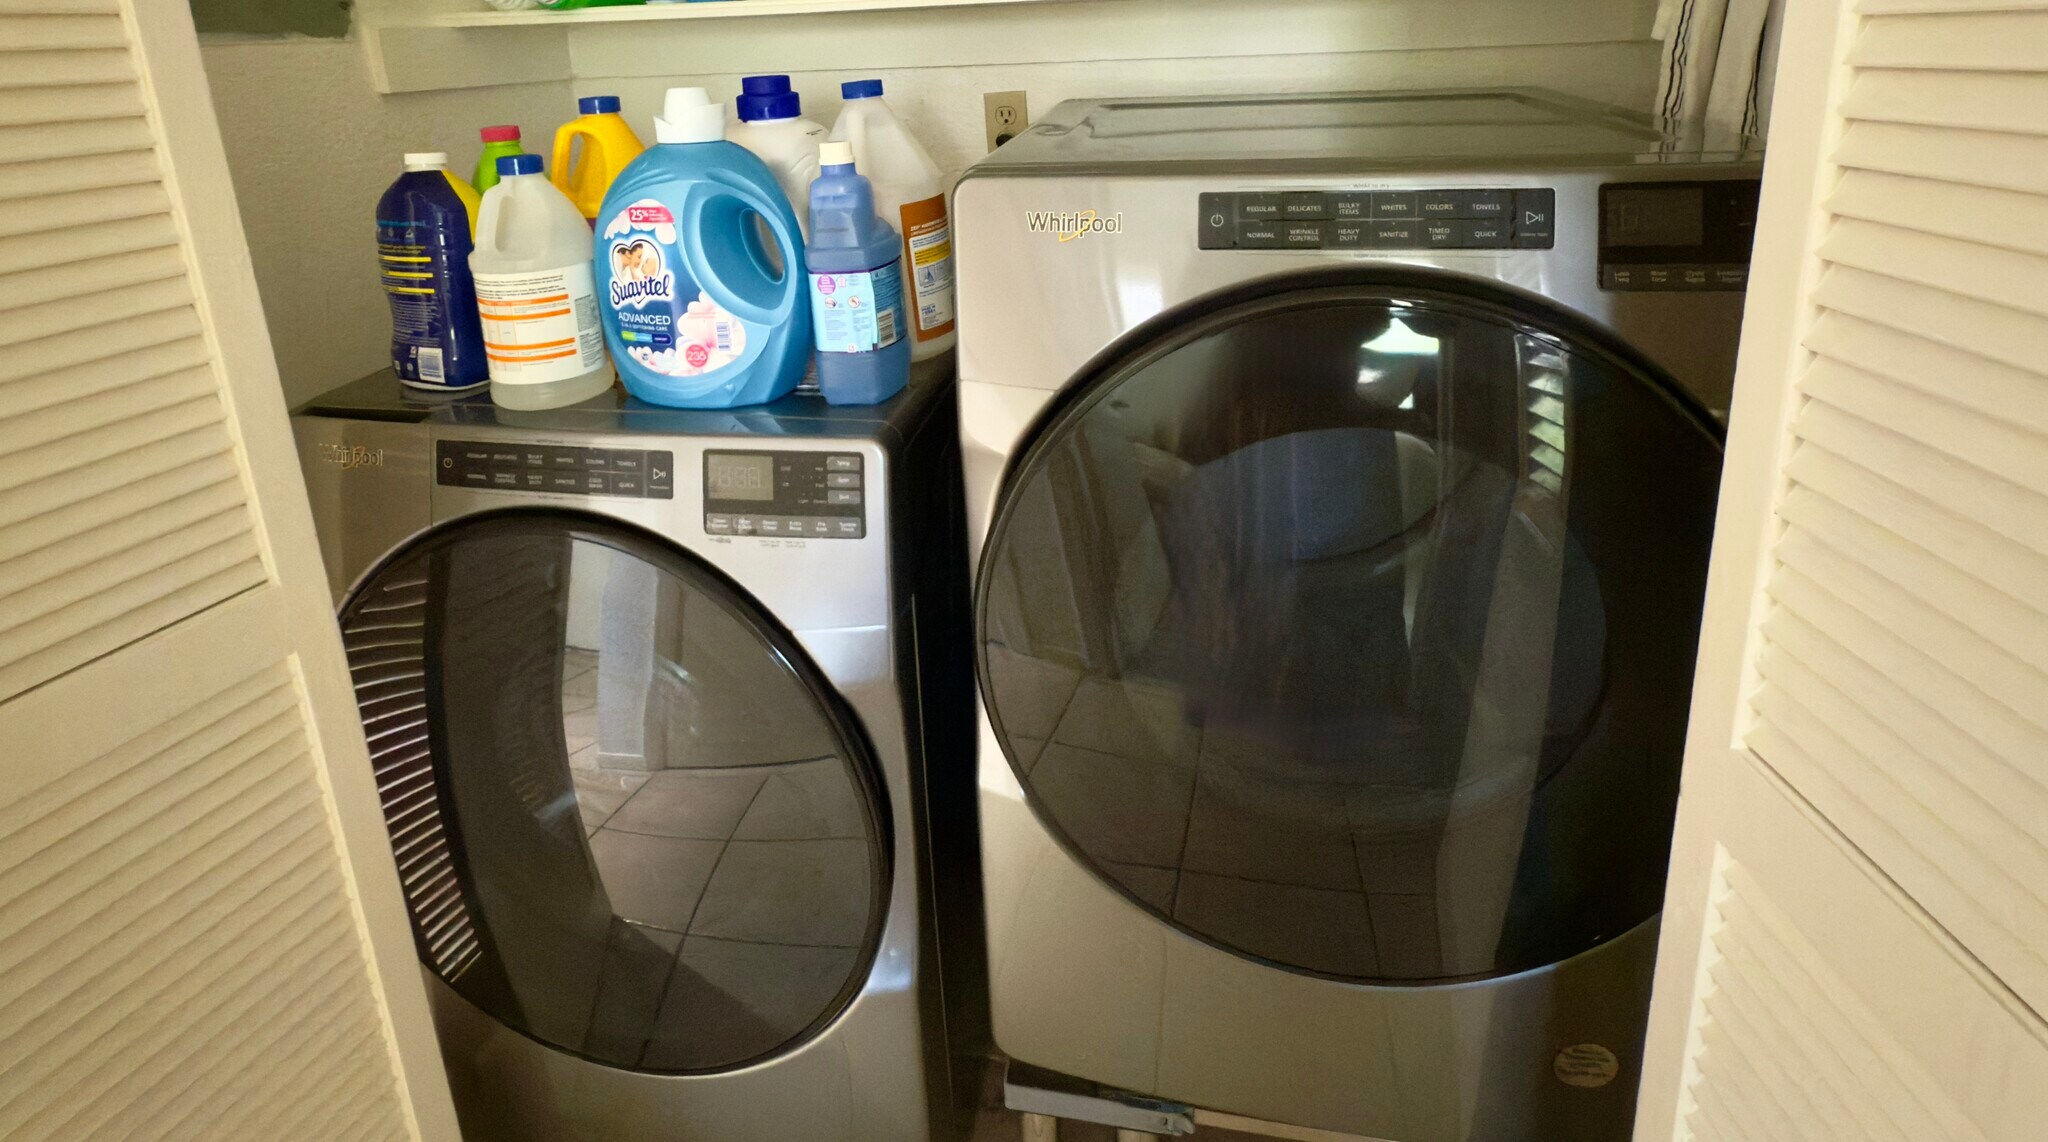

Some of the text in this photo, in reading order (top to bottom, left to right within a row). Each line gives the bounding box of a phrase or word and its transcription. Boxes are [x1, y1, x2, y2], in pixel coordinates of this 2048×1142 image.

[630, 209, 649, 221] 25%
[1026, 211, 1123, 239] Whirlpool
[1432, 233, 1447, 241] DRY
[611, 274, 670, 305] Suavitel
[618, 311, 671, 326] ADVANCED
[687, 350, 707, 361] 235
